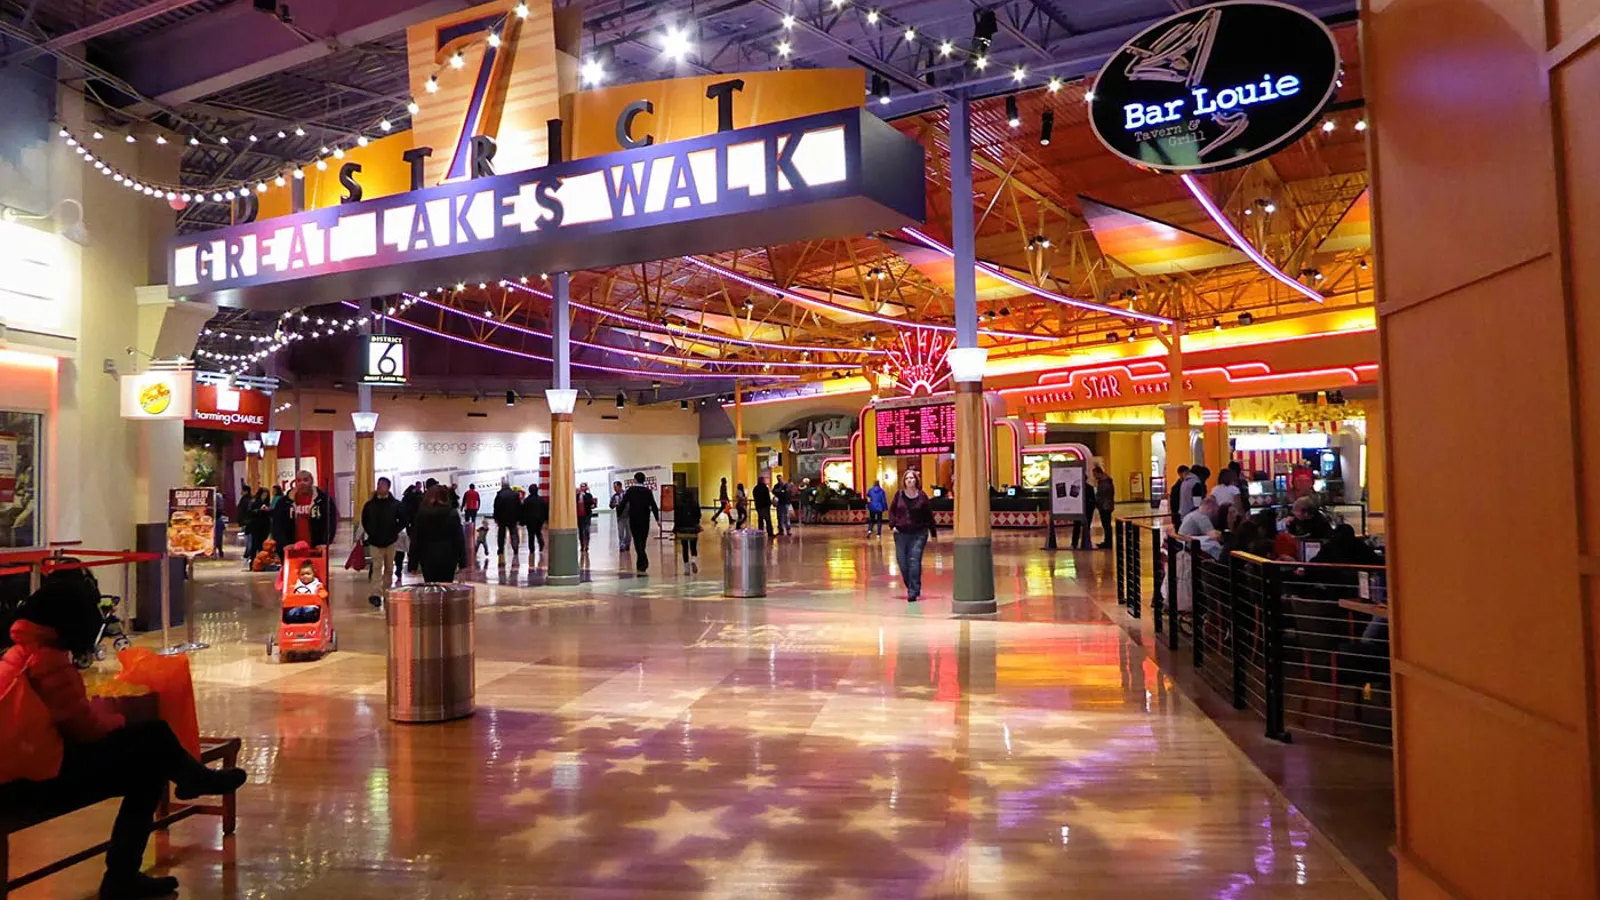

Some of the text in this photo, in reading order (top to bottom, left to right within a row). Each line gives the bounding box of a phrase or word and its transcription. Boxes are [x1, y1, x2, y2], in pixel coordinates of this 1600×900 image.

[436, 11, 511, 185] 7
[1124, 74, 1301, 130] Bar Louie
[1134, 119, 1201, 143] Tavern &
[1168, 132, 1206, 147] Grill
[194, 128, 810, 286] GREAT LAKES WALK
[370, 336, 403, 344] DISTRICT
[377, 342, 397, 376] 6
[1024, 375, 1194, 405] THEATRES STAR THEATS
[195, 409, 264, 425] harming CHARLIE
[415, 440, 468, 455] shopping
